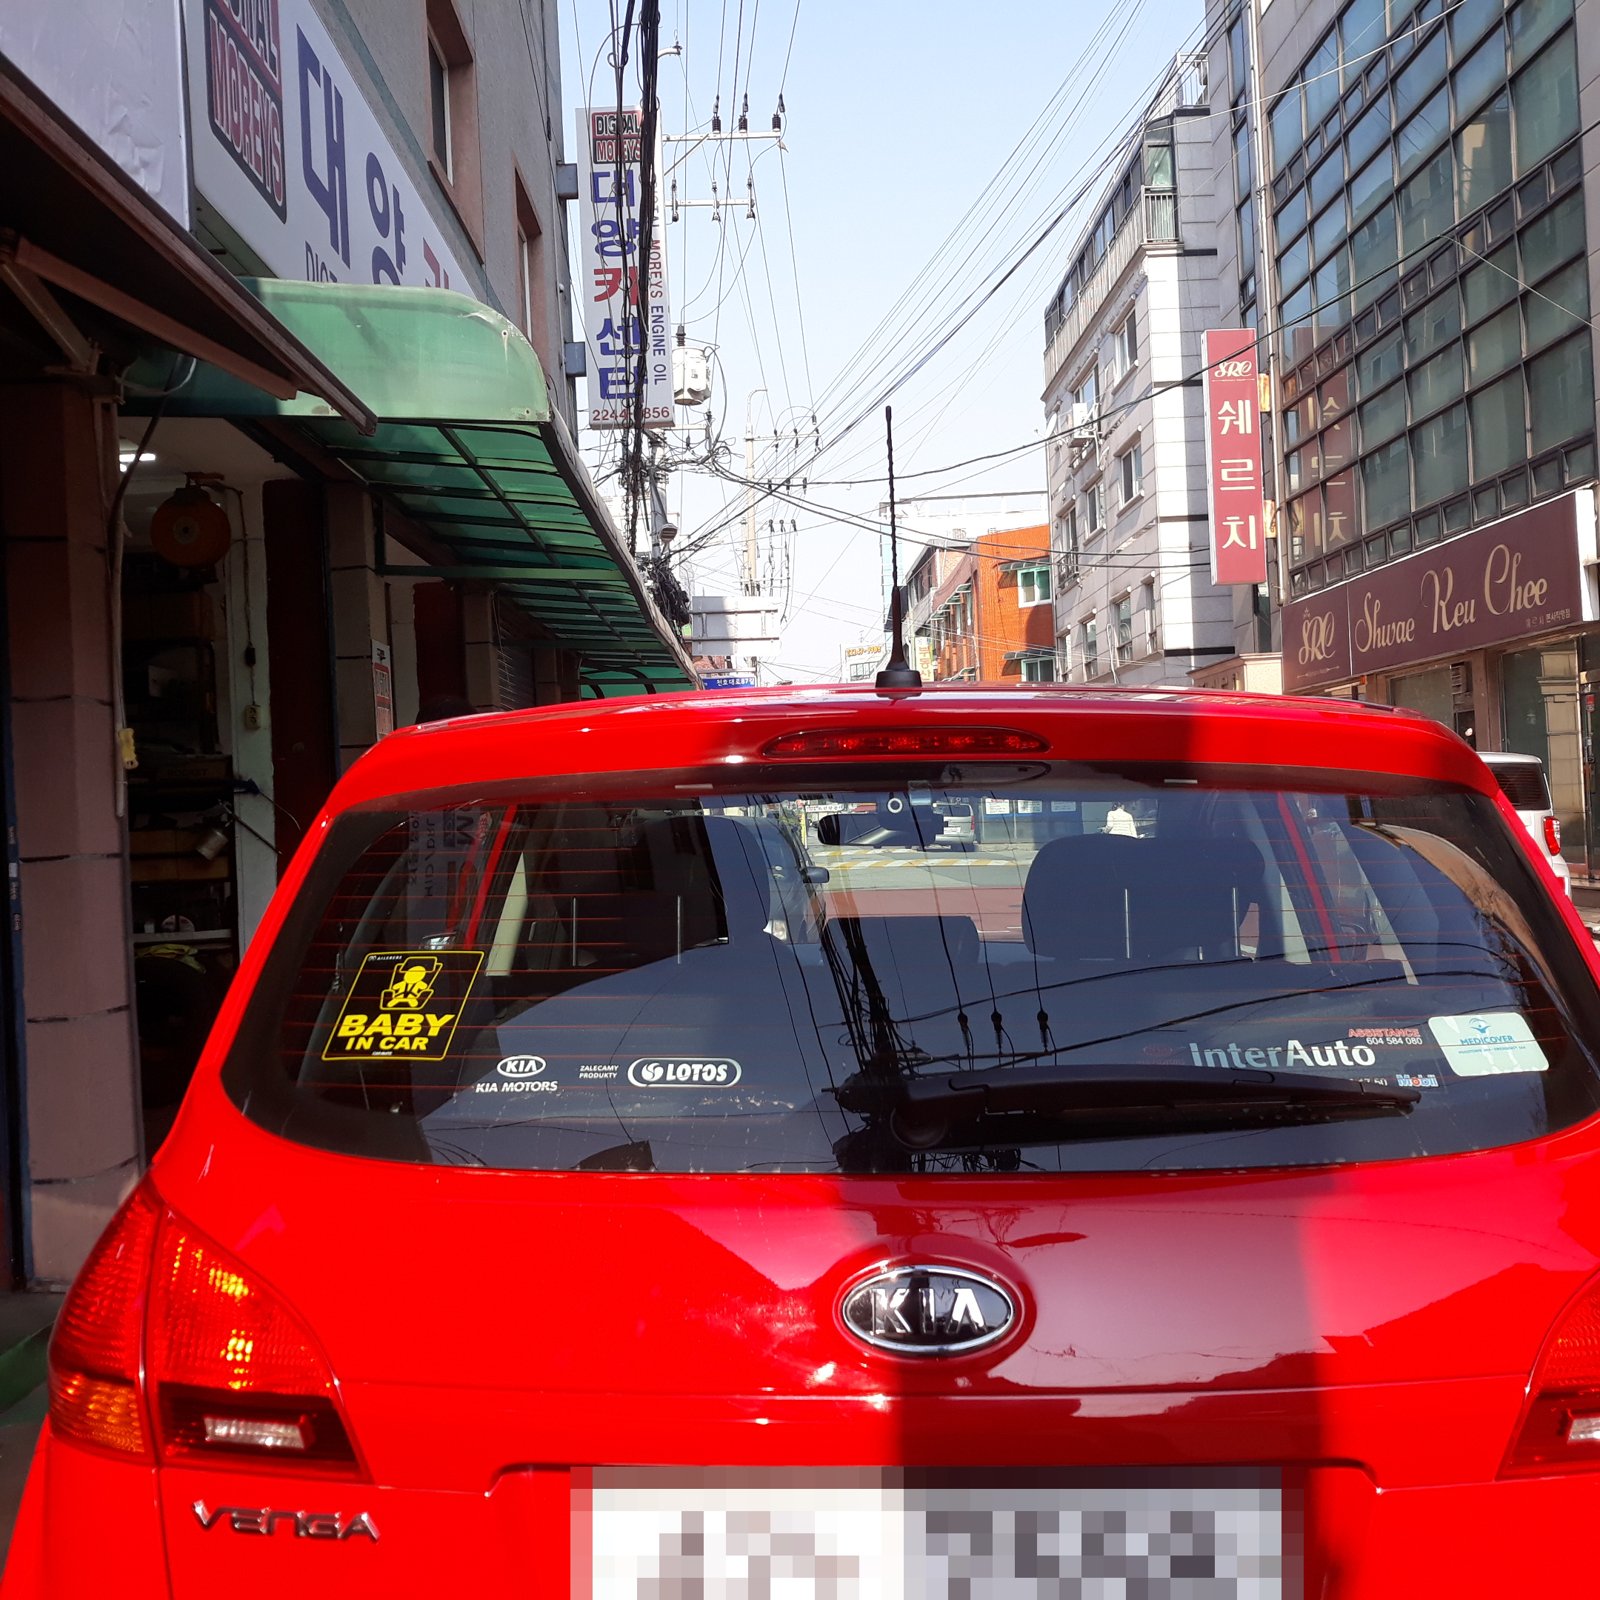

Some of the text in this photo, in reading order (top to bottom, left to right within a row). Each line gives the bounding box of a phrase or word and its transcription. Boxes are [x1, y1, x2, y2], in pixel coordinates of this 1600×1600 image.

[209, 10, 283, 207] MOREYS
[650, 305, 666, 357] ENGINE
[653, 364, 667, 385] OIL
[1355, 591, 1415, 653] Shwae
[1484, 544, 1548, 616] Chee
[337, 1013, 456, 1037] BABY
[1348, 1028, 1421, 1038] ASSISTANCE
[344, 1036, 429, 1051] IN CAR
[1366, 1037, 1423, 1045] 604 584 080
[1460, 1034, 1515, 1046] MEDICOVER
[1189, 1039, 1377, 1068] InterAuto
[506, 1061, 538, 1073] KIA
[580, 1064, 619, 1072] ZALECAMY
[665, 1063, 728, 1081] LOTOS
[475, 1080, 558, 1093] KIA MOTORS
[1396, 1074, 1439, 1087] Mobil
[869, 1288, 988, 1335] KIA
